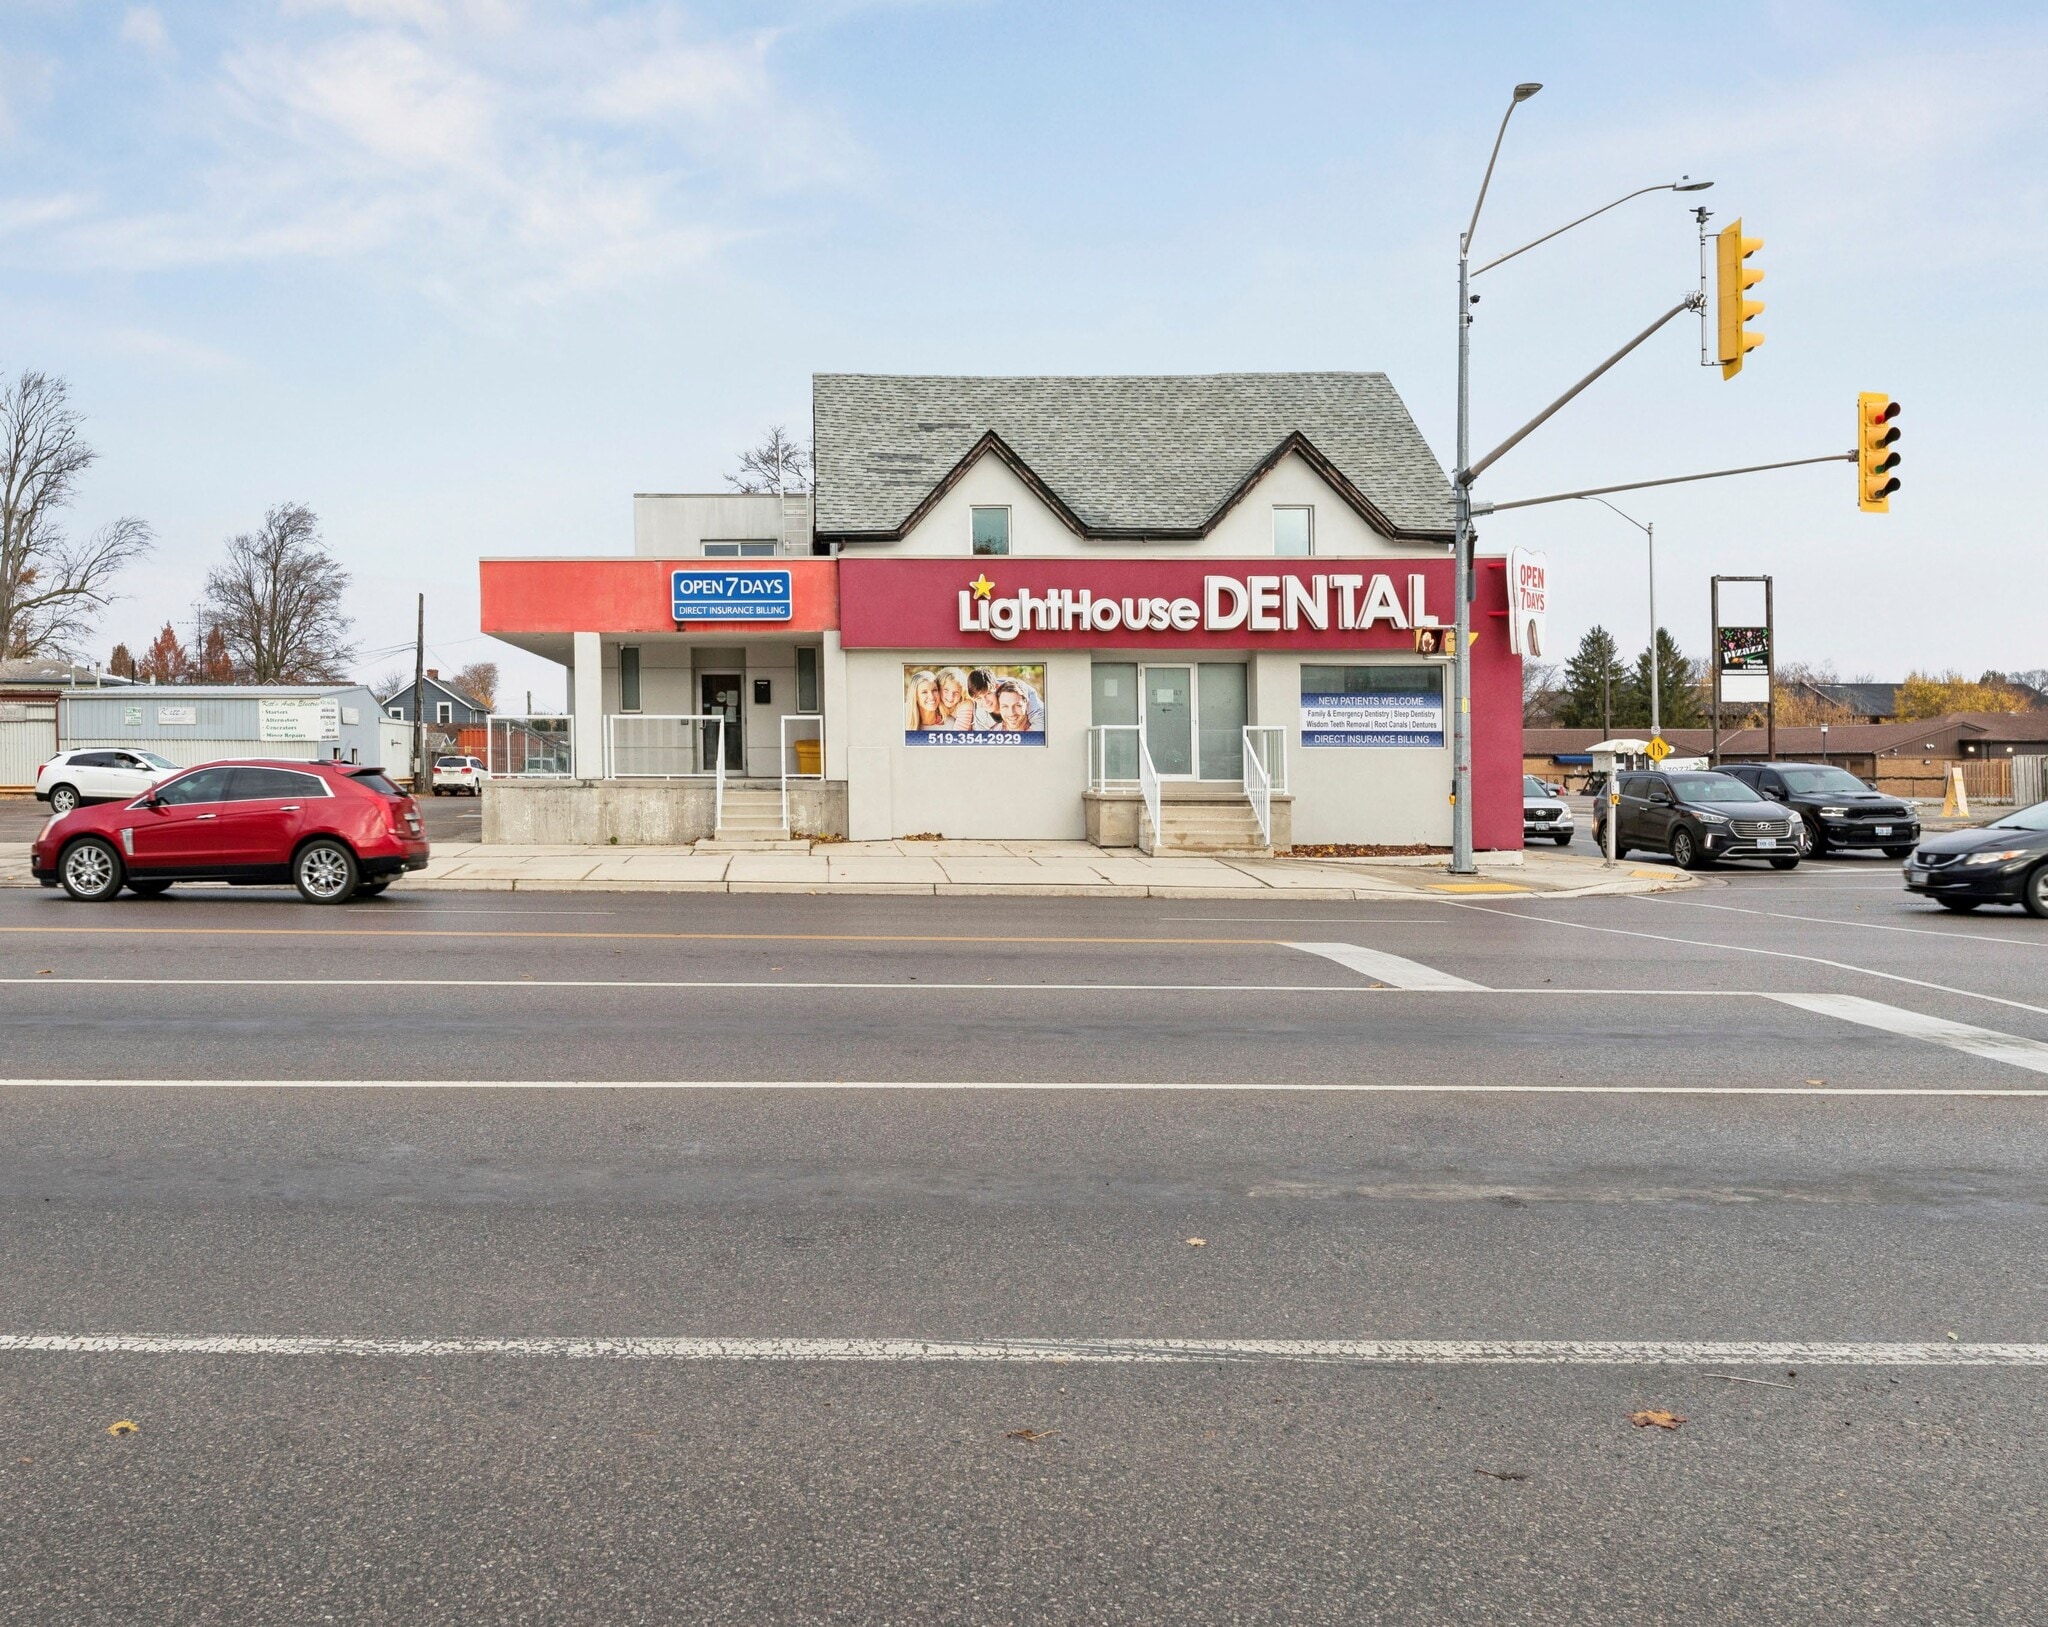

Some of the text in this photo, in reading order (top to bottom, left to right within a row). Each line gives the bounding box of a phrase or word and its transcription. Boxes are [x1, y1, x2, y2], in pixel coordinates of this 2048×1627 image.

[1520, 564, 1544, 589] OPEN
[680, 577, 784, 596] OPEN 7 DAYS
[1520, 587, 1545, 611] 7 DAYS
[679, 606, 785, 615] DIRECT INSURANCE BILLING
[958, 573, 1439, 641] LightHouse DENTAL
[1723, 638, 1768, 664] pizazz!
[1318, 697, 1424, 706] NEW PATIENTS WELCOME
[1307, 710, 1326, 719] Family
[1333, 710, 1363, 719] Emergency
[1364, 710, 1390, 719] Dentistry
[1394, 710, 1409, 719] Sleep
[1410, 710, 1436, 719] Dentistry
[1306, 720, 1437, 728] Wisdom Teeth Removal Root Canals Dentures
[928, 733, 1022, 745] 519-354-2929
[1314, 735, 1430, 744] DIRECT INSURANCE BILLING
